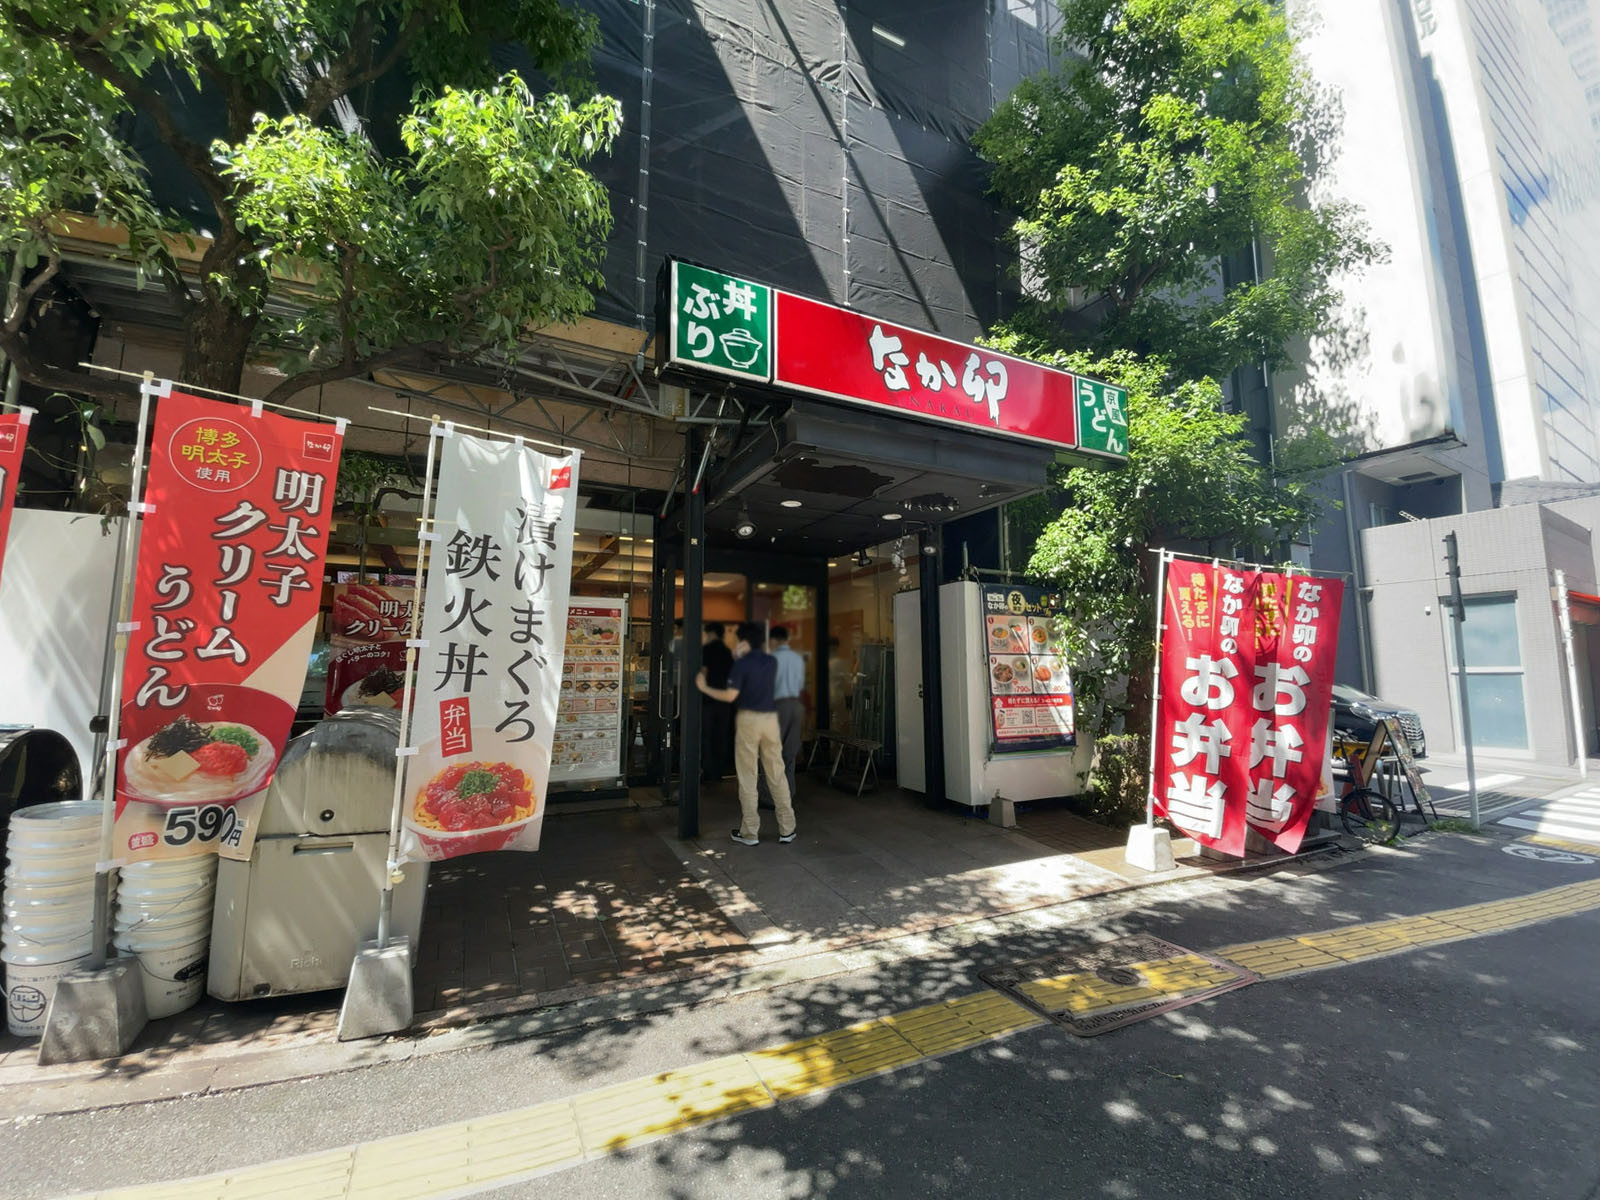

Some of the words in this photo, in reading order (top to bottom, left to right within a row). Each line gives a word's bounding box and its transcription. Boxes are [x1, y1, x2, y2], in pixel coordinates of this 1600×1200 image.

[682, 282, 721, 359] ぶり
[723, 280, 757, 320] 丼
[868, 324, 1008, 426] なか卯
[910, 396, 975, 418] NAKAU
[181, 444, 250, 470] 明太子
[195, 426, 240, 448] 博多
[1079, 381, 1124, 454] うどん
[195, 466, 231, 484] 使用
[259, 466, 327, 608] 明太子
[196, 500, 270, 666] クリーム
[433, 529, 502, 693] 鉄火丼
[495, 496, 563, 744] 漬けまぐろ
[1219, 572, 1245, 655] なか卯の
[1291, 581, 1323, 663] なか卯の
[135, 563, 196, 710] うどん
[443, 703, 468, 752] 弁当
[1166, 654, 1239, 840] お弁当
[1248, 662, 1312, 834] お弁当
